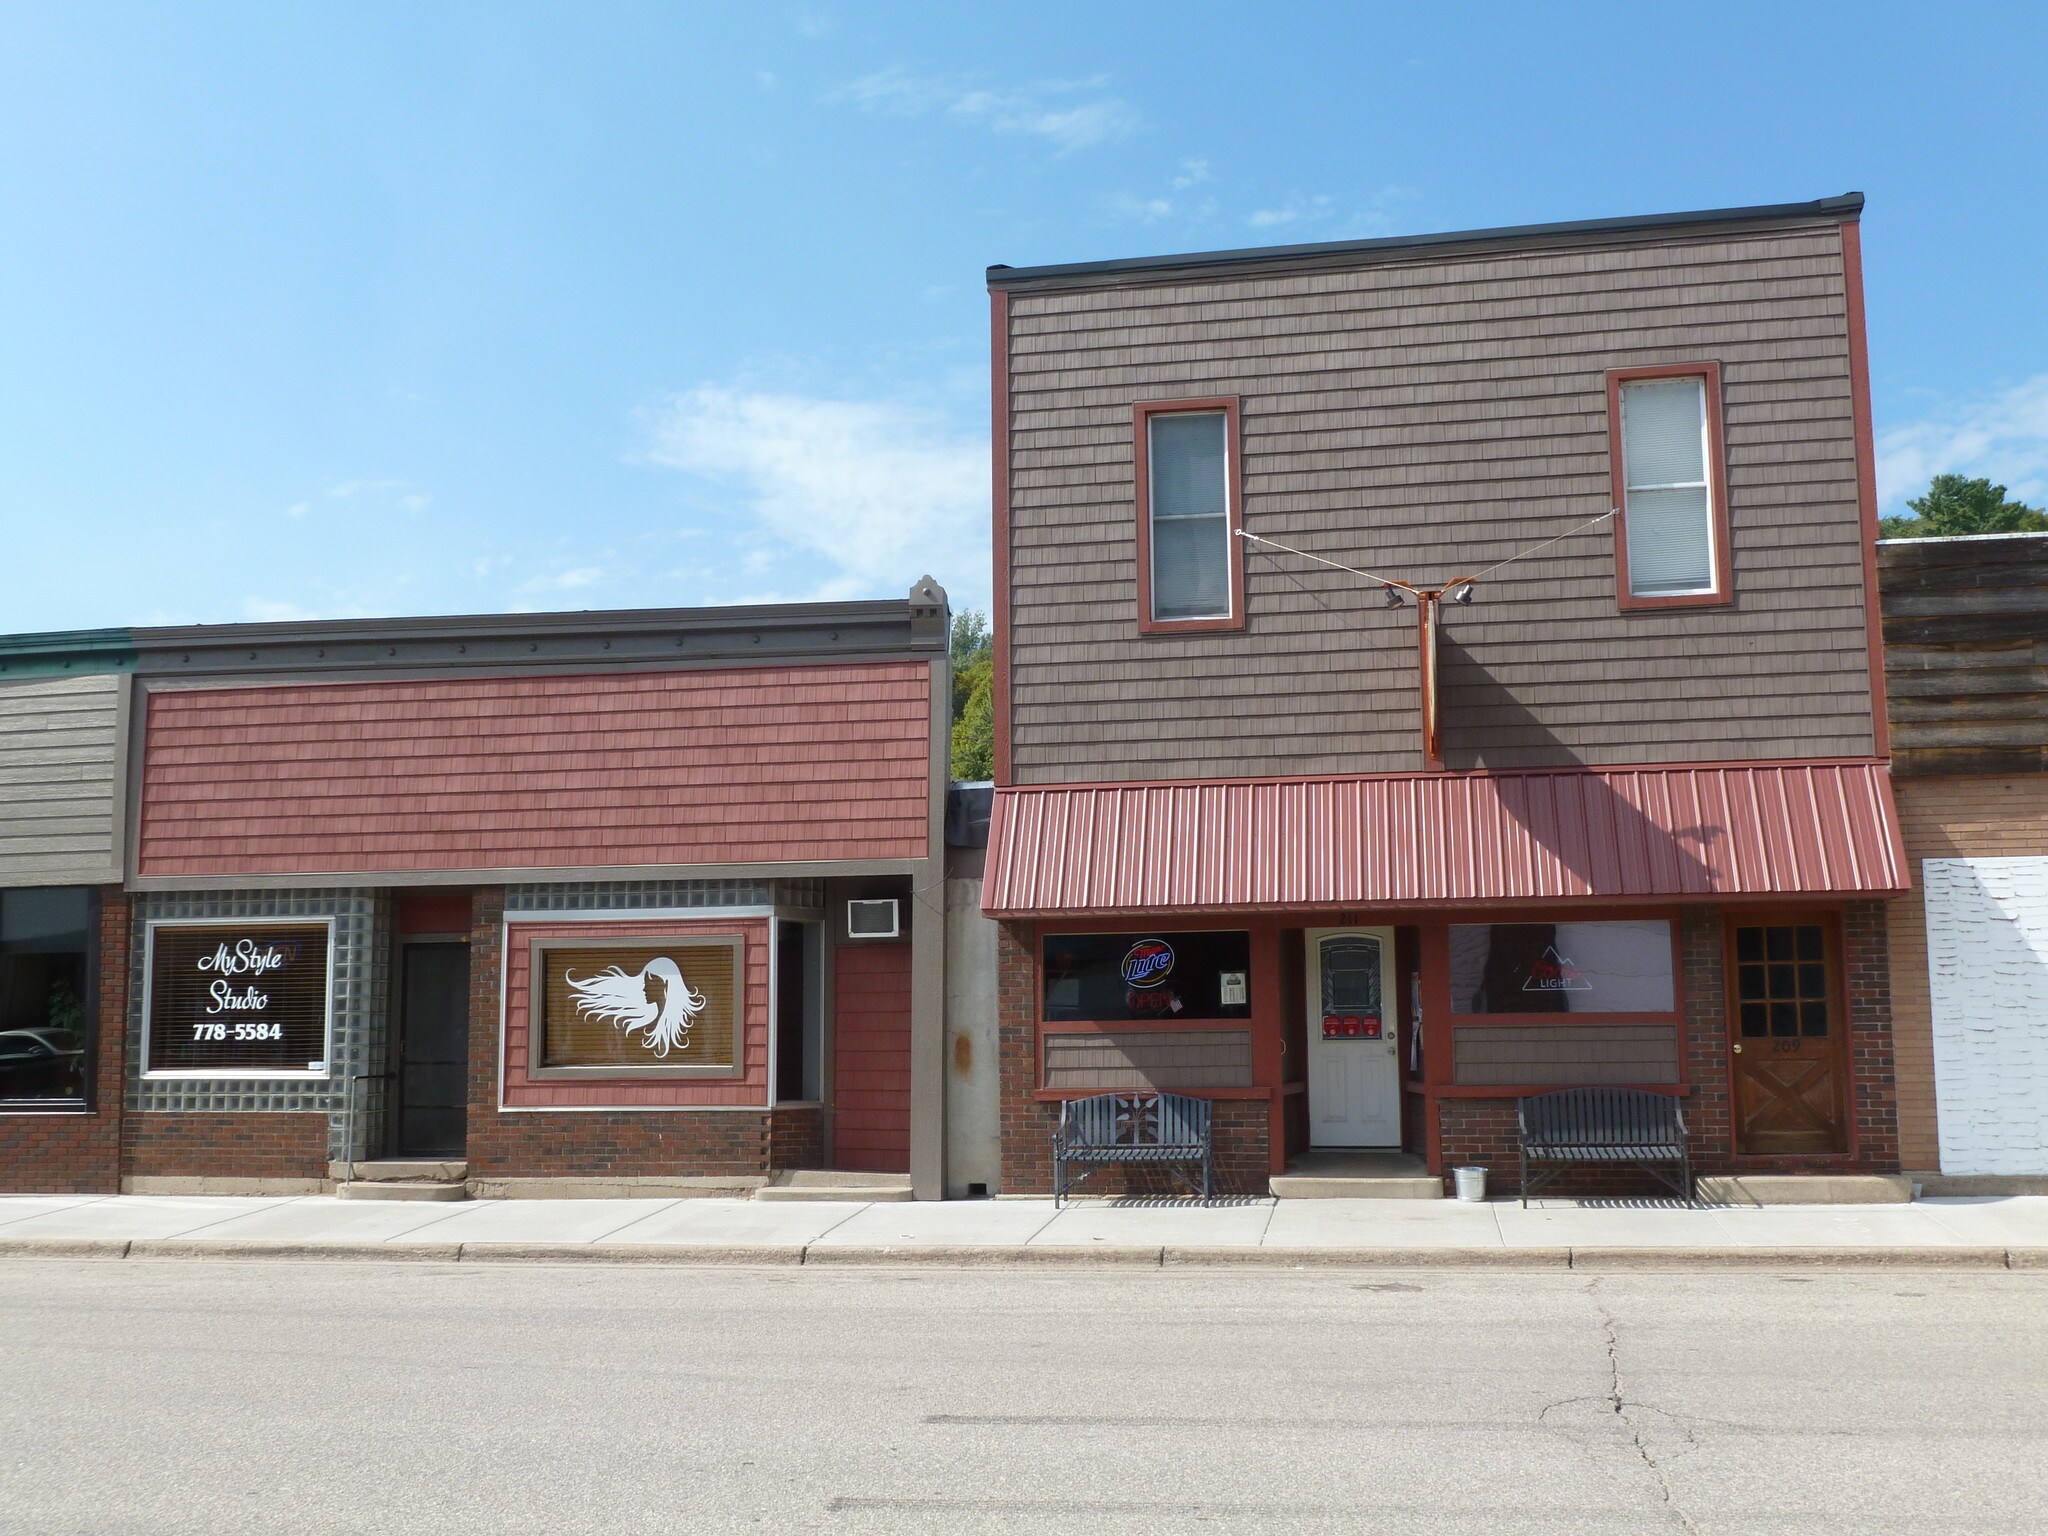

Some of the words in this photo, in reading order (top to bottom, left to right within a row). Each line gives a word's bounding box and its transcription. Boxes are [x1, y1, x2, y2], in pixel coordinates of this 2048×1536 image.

[1339, 913, 1358, 925] 211
[1540, 978, 1573, 988] LIGHT
[206, 979, 269, 1014] Studio
[1127, 991, 1174, 1010] OPEN
[192, 1023, 283, 1041] 778-5584
[1772, 1040, 1801, 1053] 209
